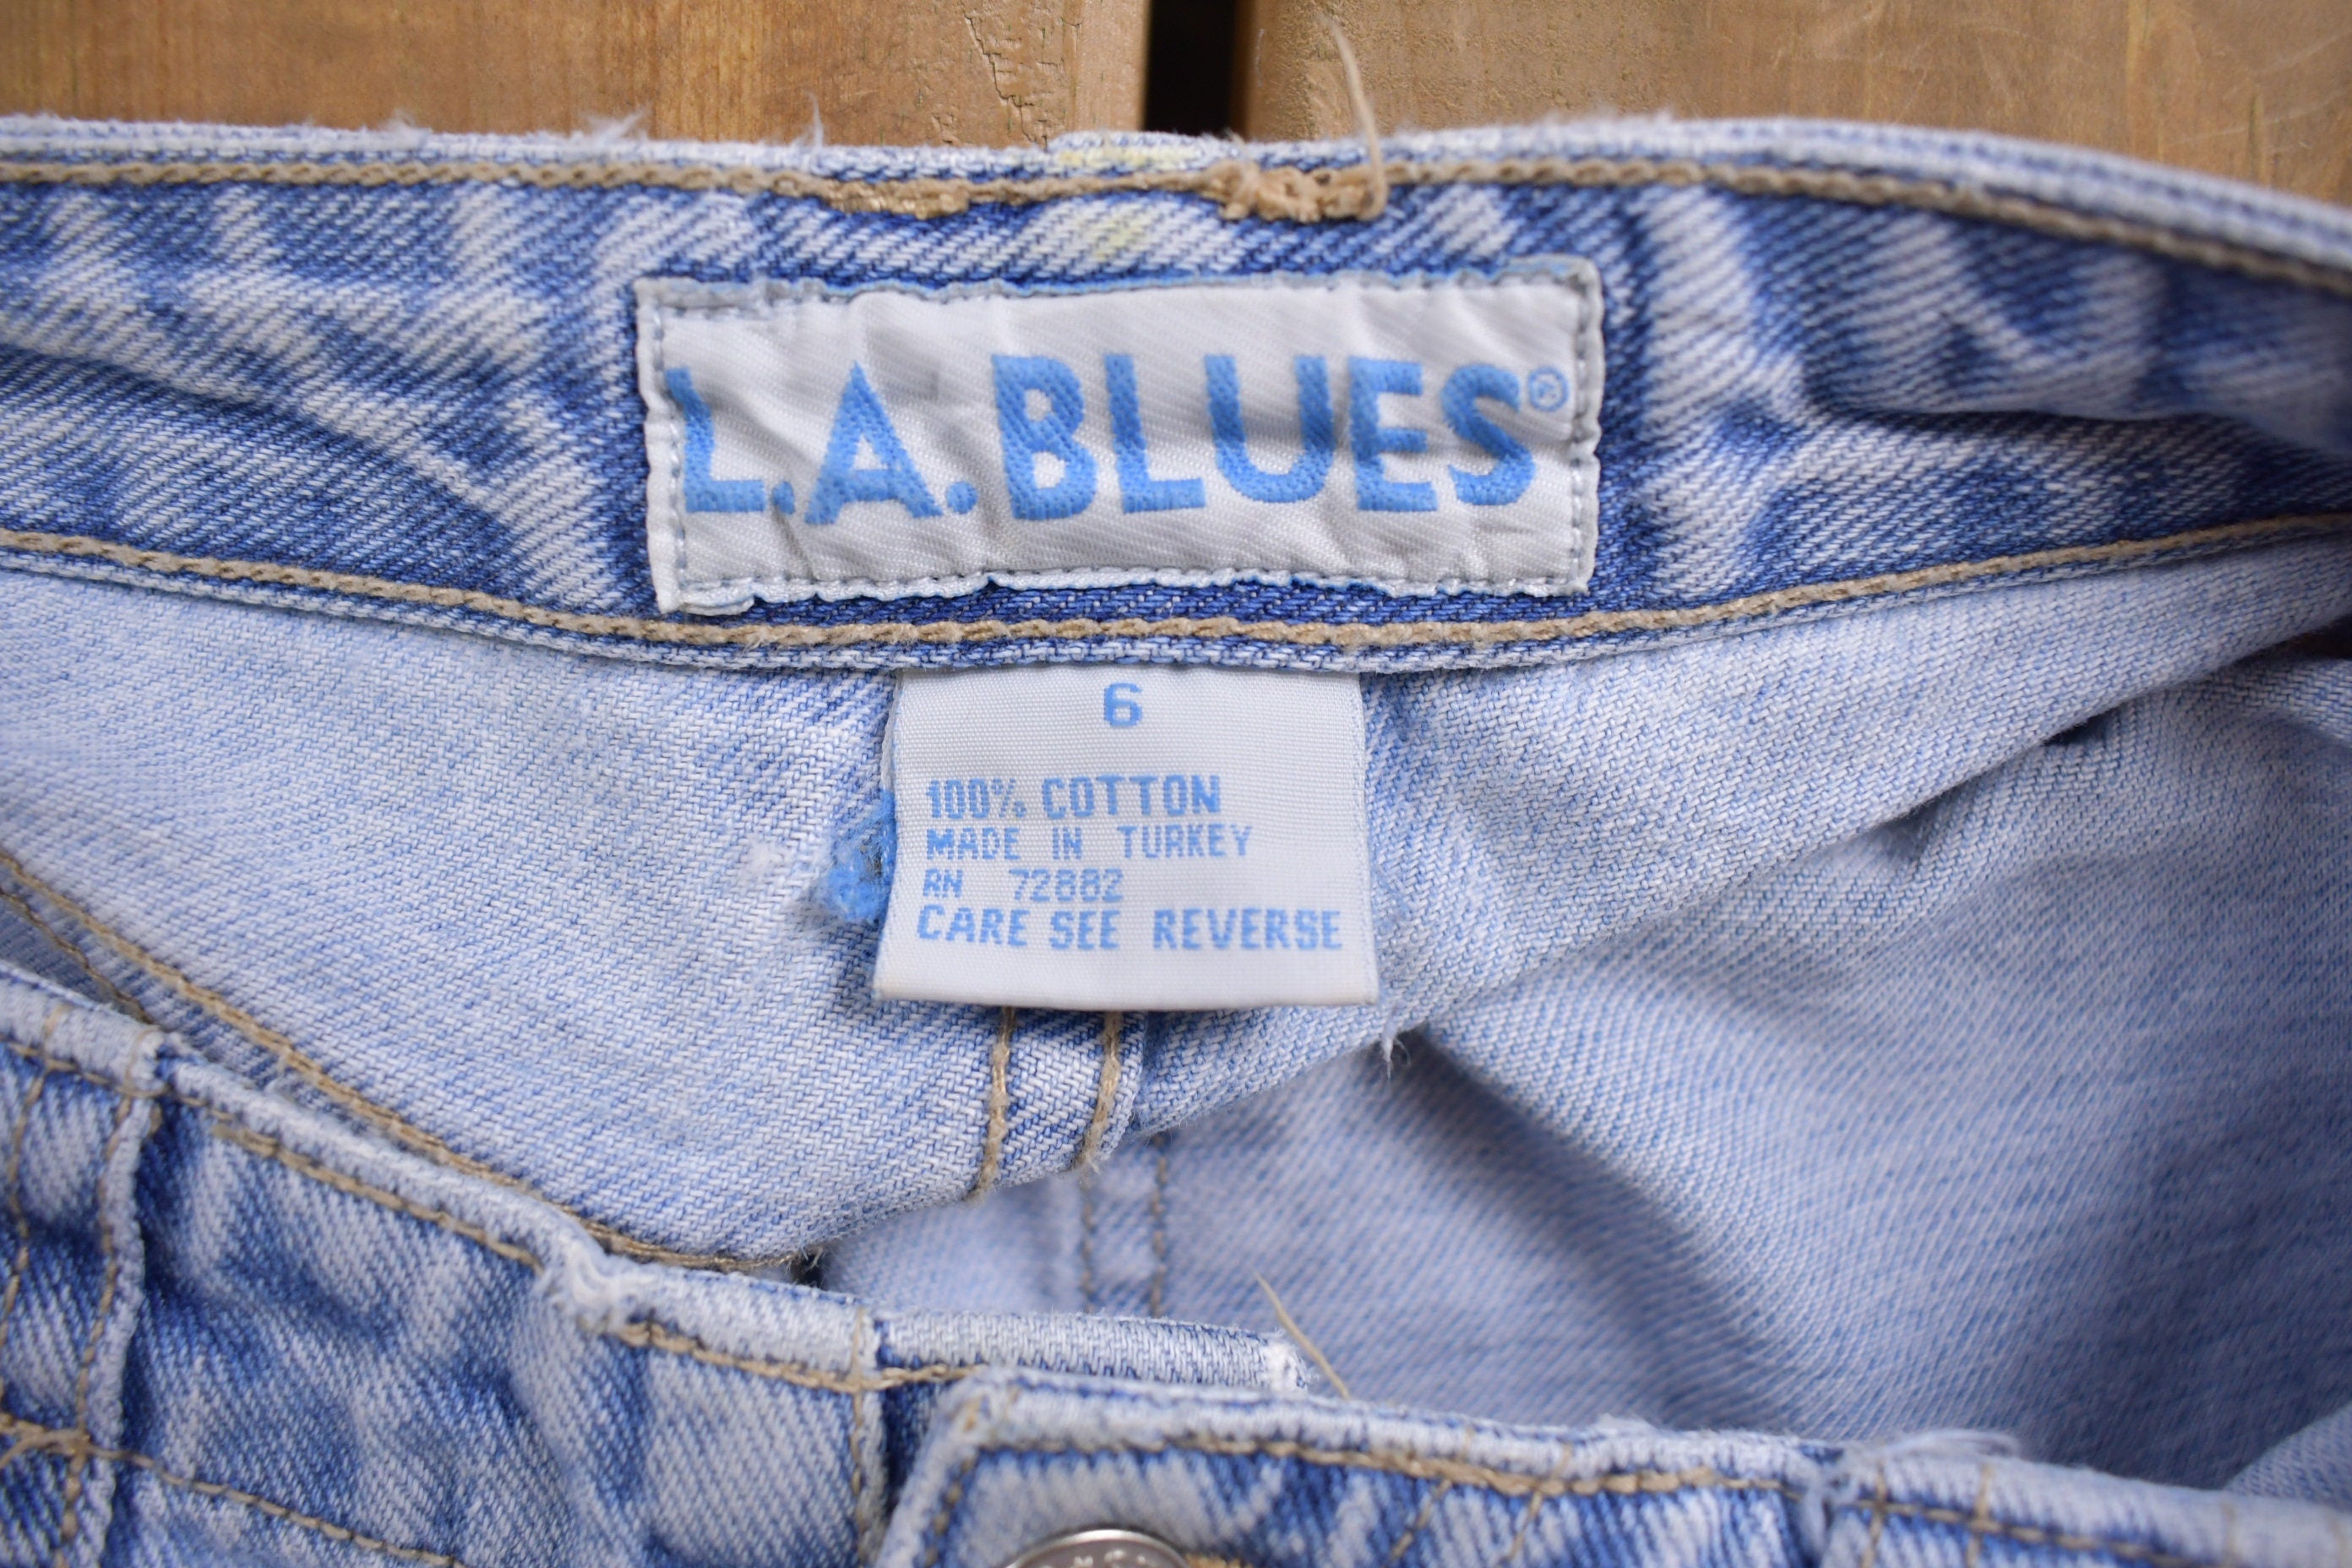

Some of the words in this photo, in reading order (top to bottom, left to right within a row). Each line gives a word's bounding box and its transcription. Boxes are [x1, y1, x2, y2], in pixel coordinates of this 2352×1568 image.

[1102, 682, 1143, 727] 6
[926, 778, 1026, 819] 100%
[1041, 775, 1222, 819] COTTON
[926, 827, 1021, 860] MADE
[1052, 825, 1083, 860] IN
[1116, 824, 1253, 859] TURKEY
[923, 868, 963, 898] RN
[1008, 868, 1124, 902] 72882
[917, 904, 1027, 946] CARE
[1048, 909, 1121, 950] SEE
[1152, 908, 1343, 951] REVERSE
